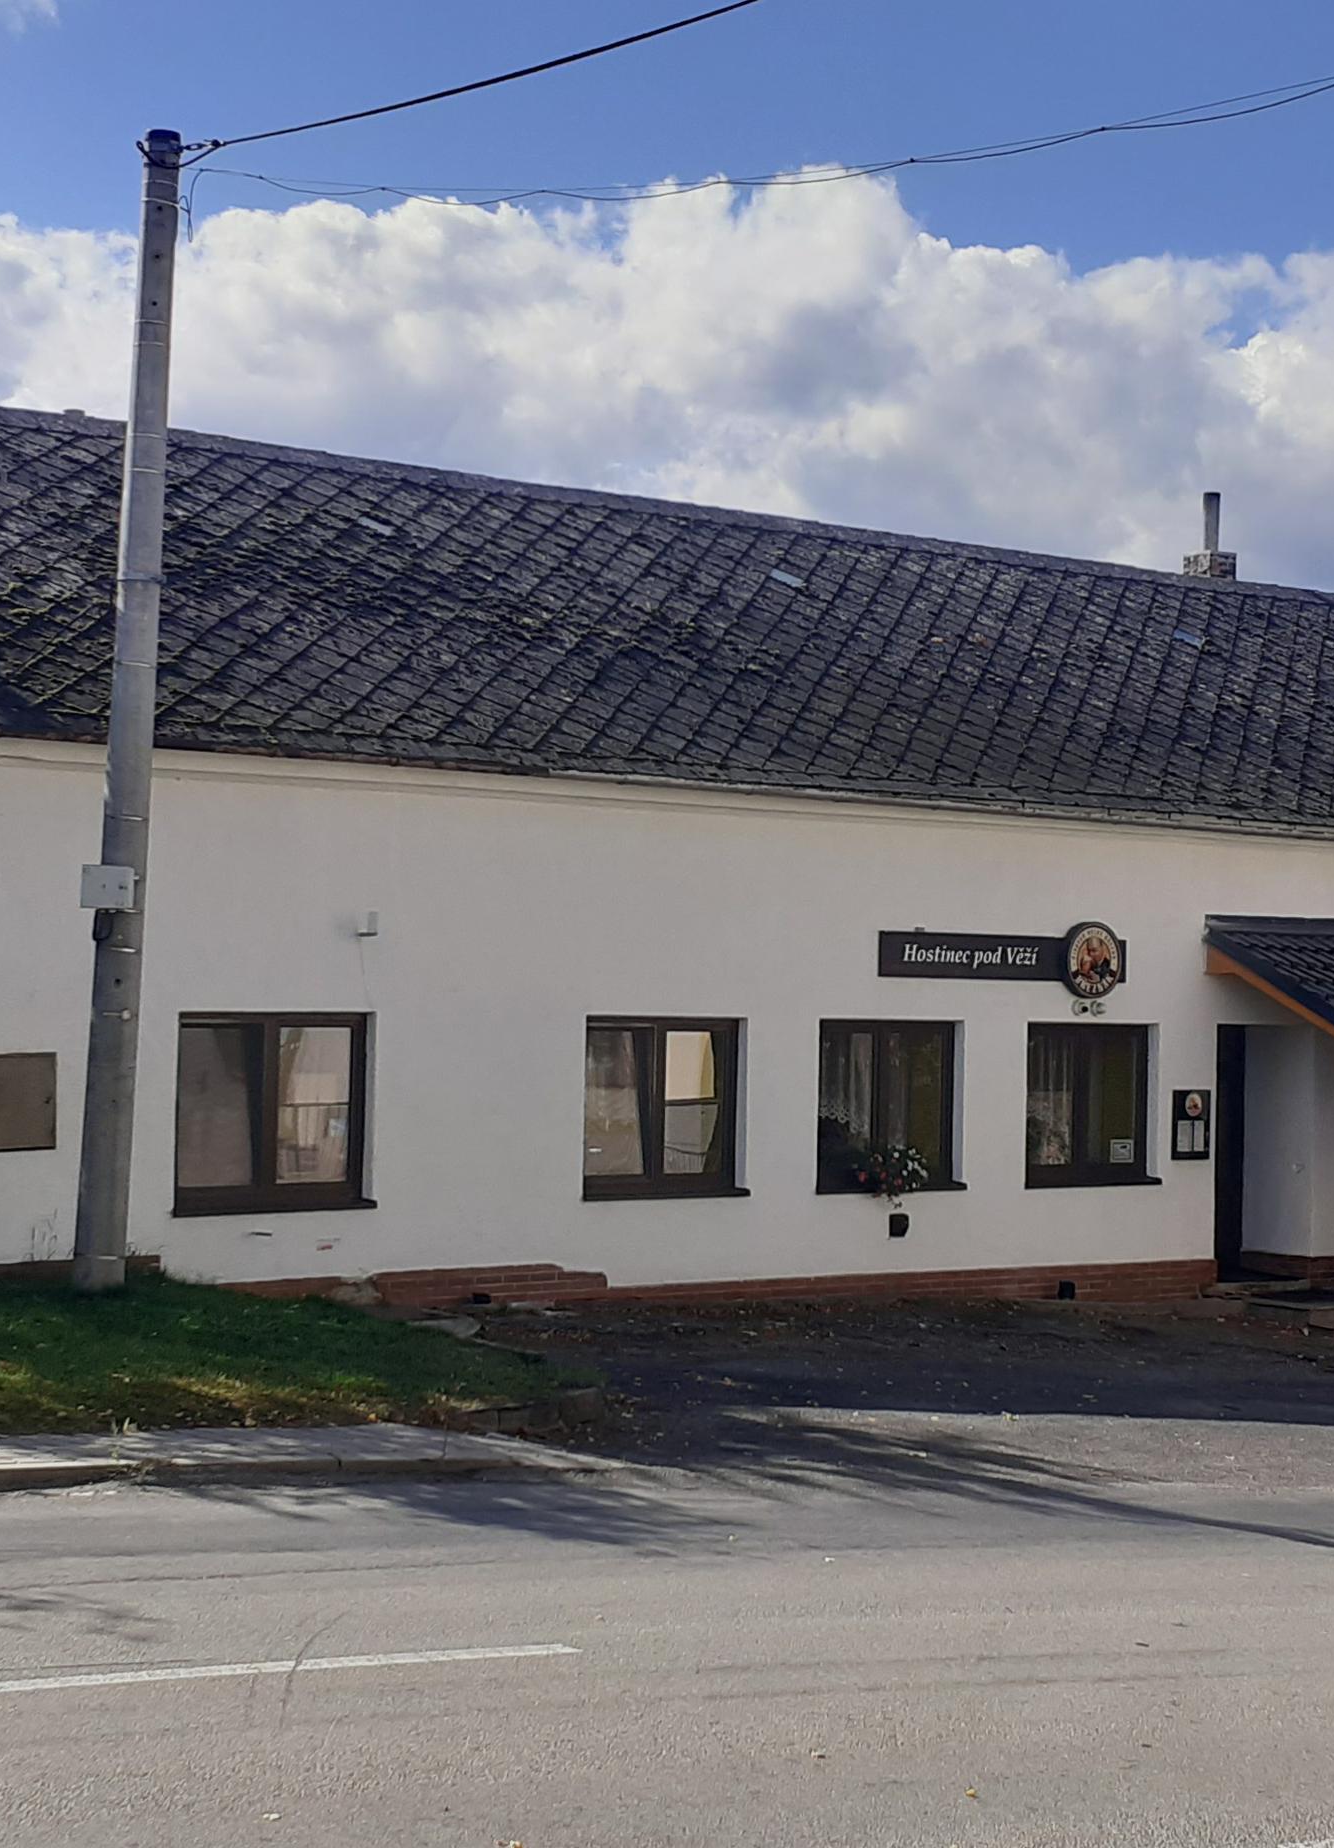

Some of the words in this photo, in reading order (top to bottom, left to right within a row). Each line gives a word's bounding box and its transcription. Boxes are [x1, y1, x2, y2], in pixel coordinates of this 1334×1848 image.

[903, 943, 971, 964] Hostinec
[972, 946, 1003, 970] pod
[1006, 946, 1039, 966] Věží
